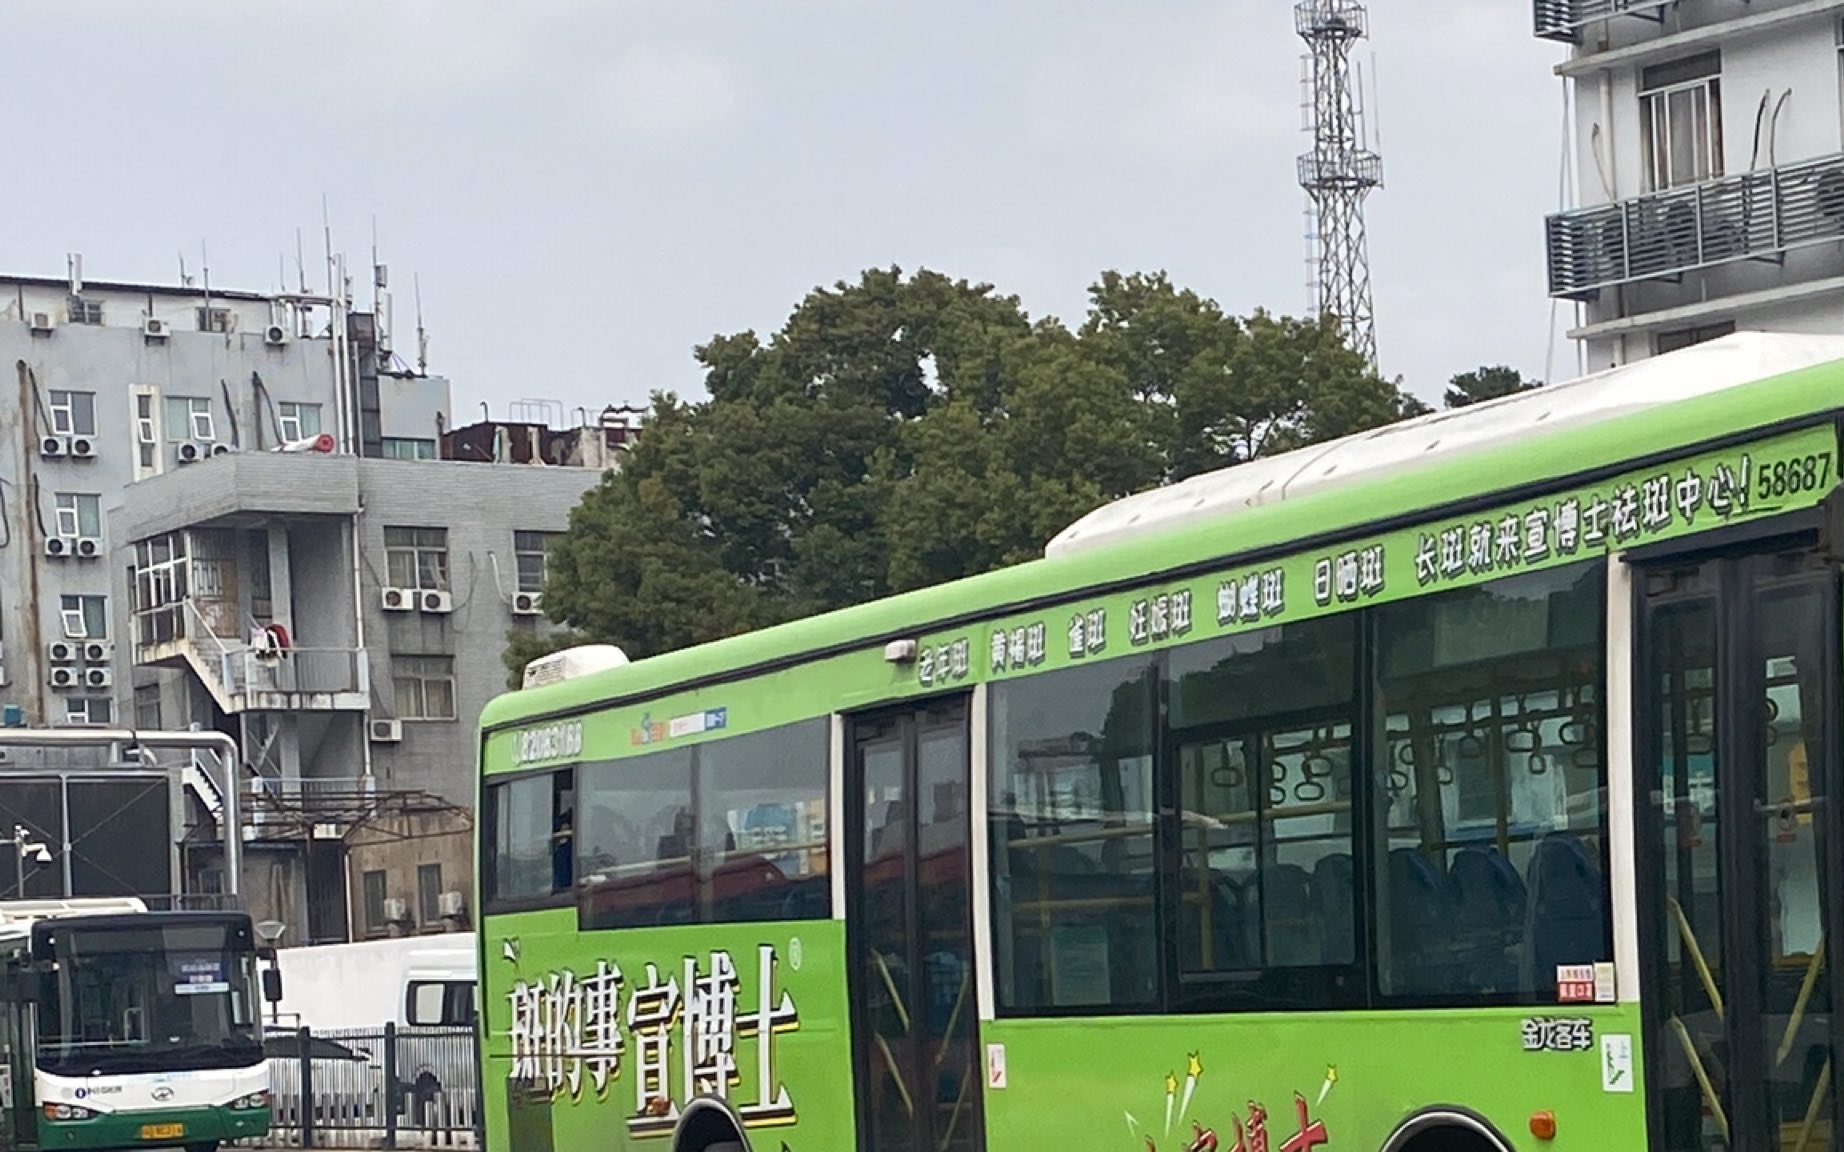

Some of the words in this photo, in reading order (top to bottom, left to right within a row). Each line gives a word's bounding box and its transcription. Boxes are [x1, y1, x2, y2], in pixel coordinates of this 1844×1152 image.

[1313, 544, 1384, 606] 日晒斑
[1758, 452, 1832, 500] 58687
[1521, 1016, 1593, 1050] 金龙客车
